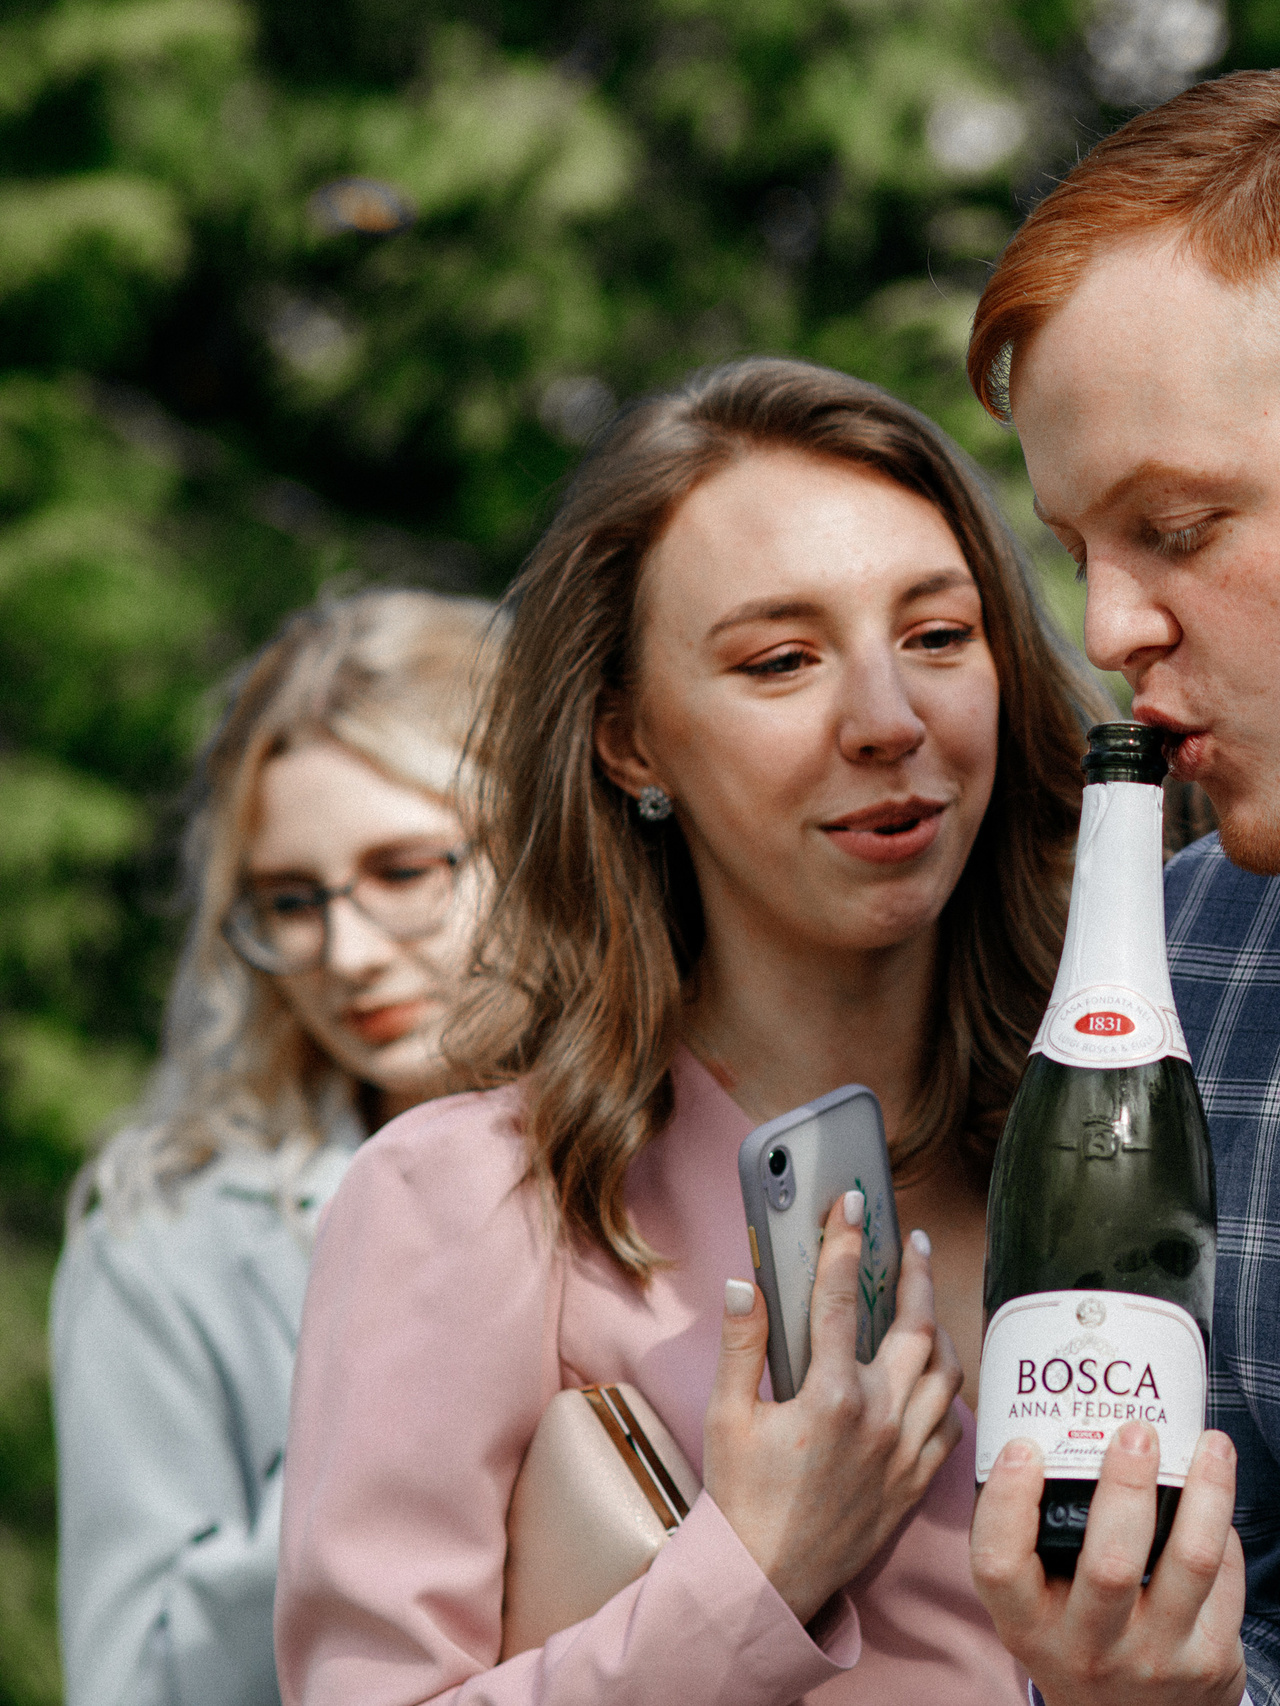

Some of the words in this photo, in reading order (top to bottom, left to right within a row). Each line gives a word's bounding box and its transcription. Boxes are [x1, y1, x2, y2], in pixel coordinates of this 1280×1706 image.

[1060, 1002, 1082, 1021] CASA
[1085, 996, 1134, 1009] FONDATA
[1089, 1016, 1122, 1032] 1831
[1081, 1042, 1117, 1054] BOSCA
[1017, 1358, 1161, 1399] BOSCA
[1008, 1401, 1061, 1418] ANNA
[1072, 1401, 1168, 1424] FEDERICA
